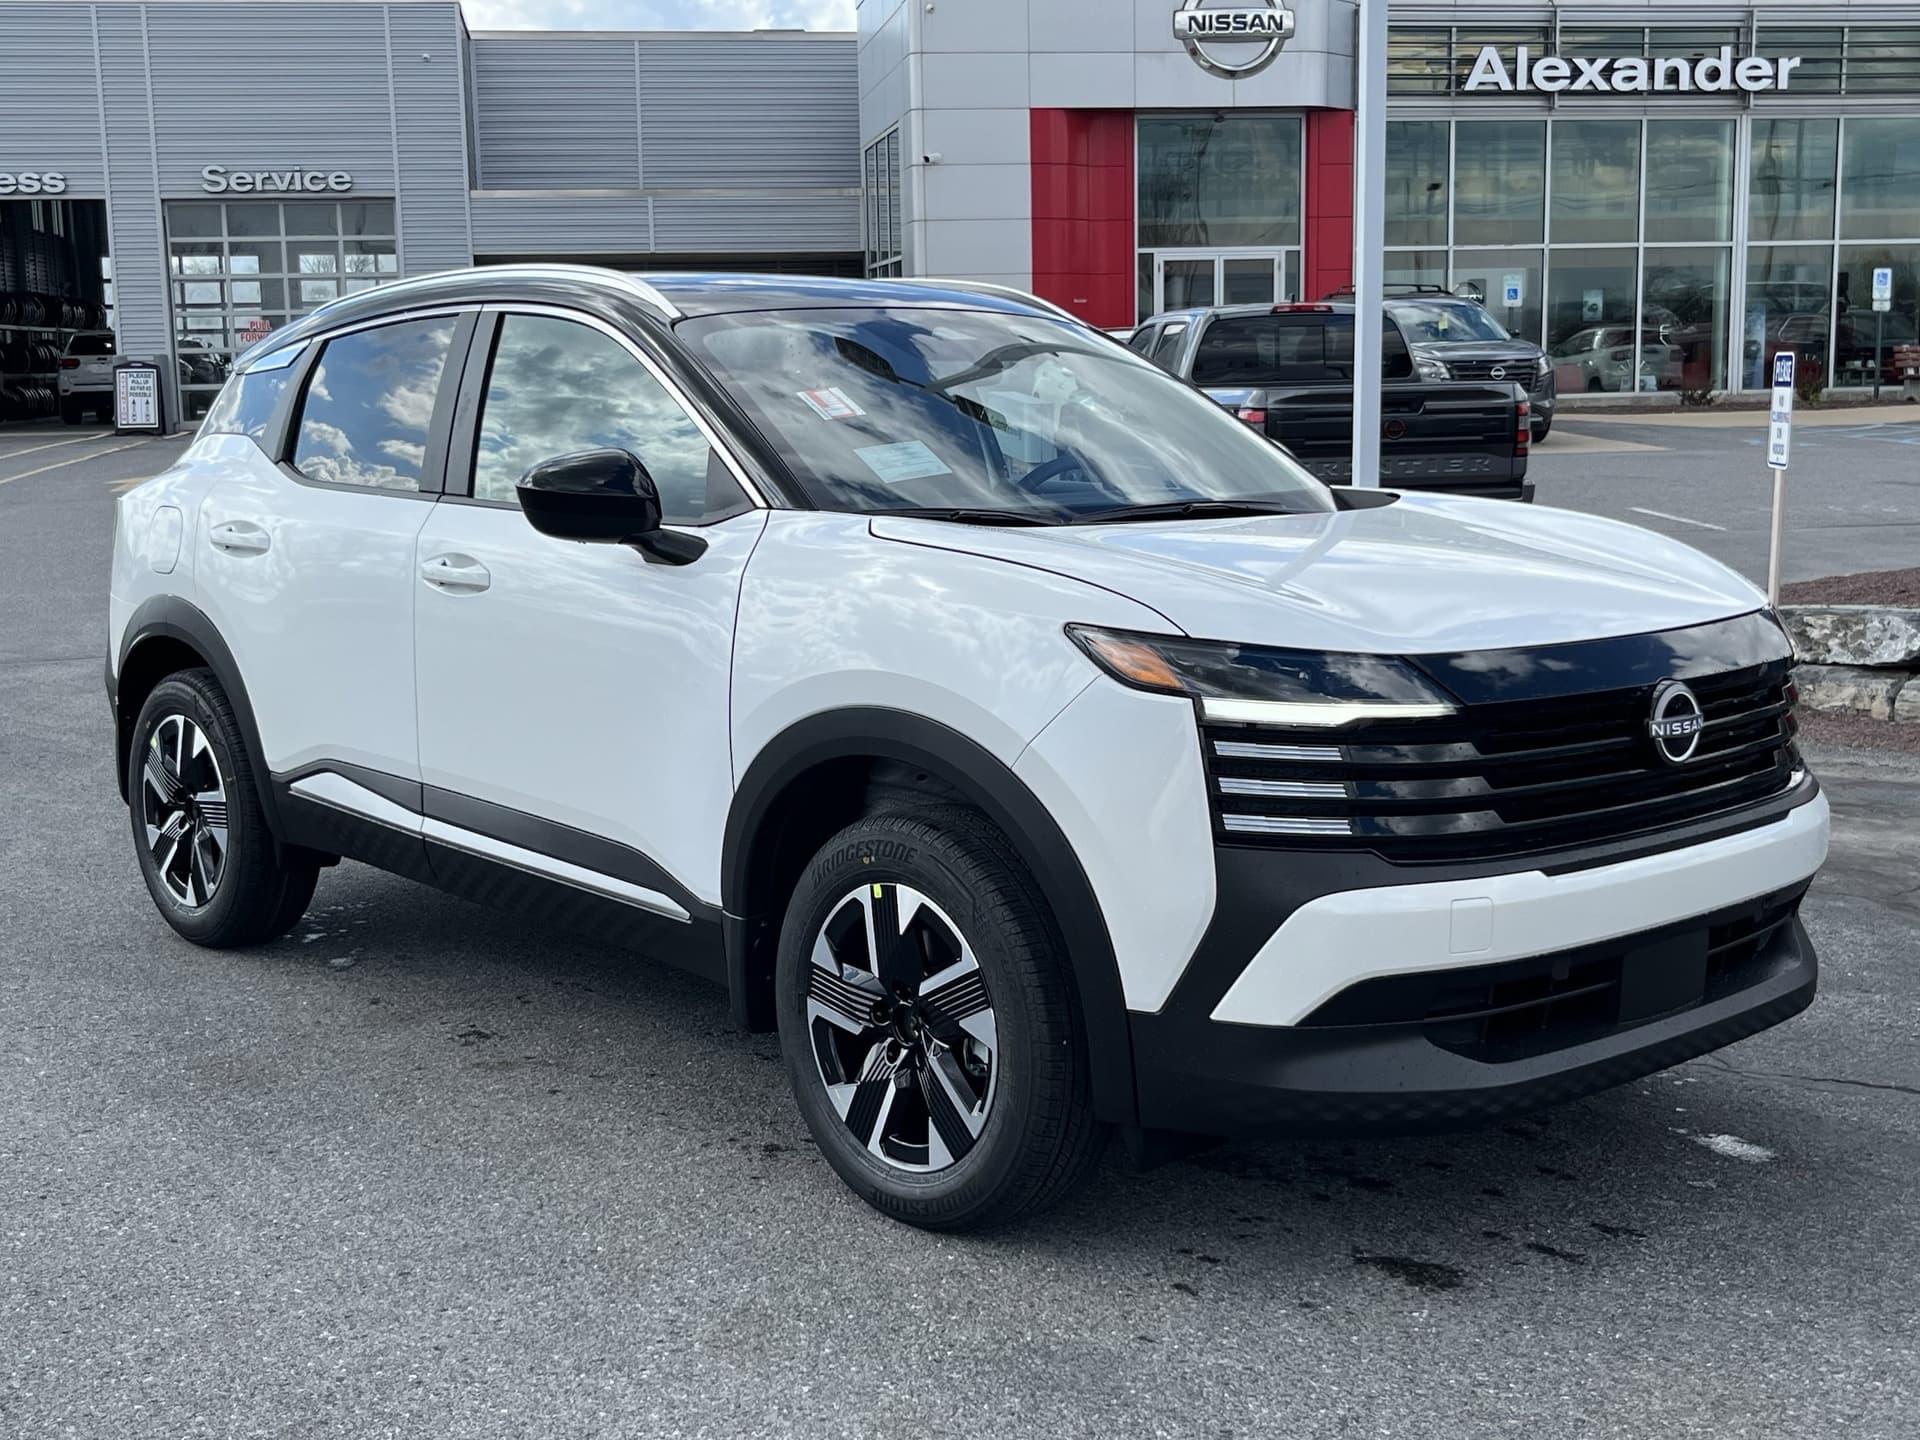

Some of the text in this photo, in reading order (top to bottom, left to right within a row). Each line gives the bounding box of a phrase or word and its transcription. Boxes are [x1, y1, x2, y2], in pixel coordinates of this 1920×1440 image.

[1188, 14, 1283, 32] NISSAN
[1464, 46, 1800, 91] Alexander
[201, 165, 353, 193] Service
[249, 320, 272, 331] PULL
[811, 839, 918, 887] BRIDGESTONE
